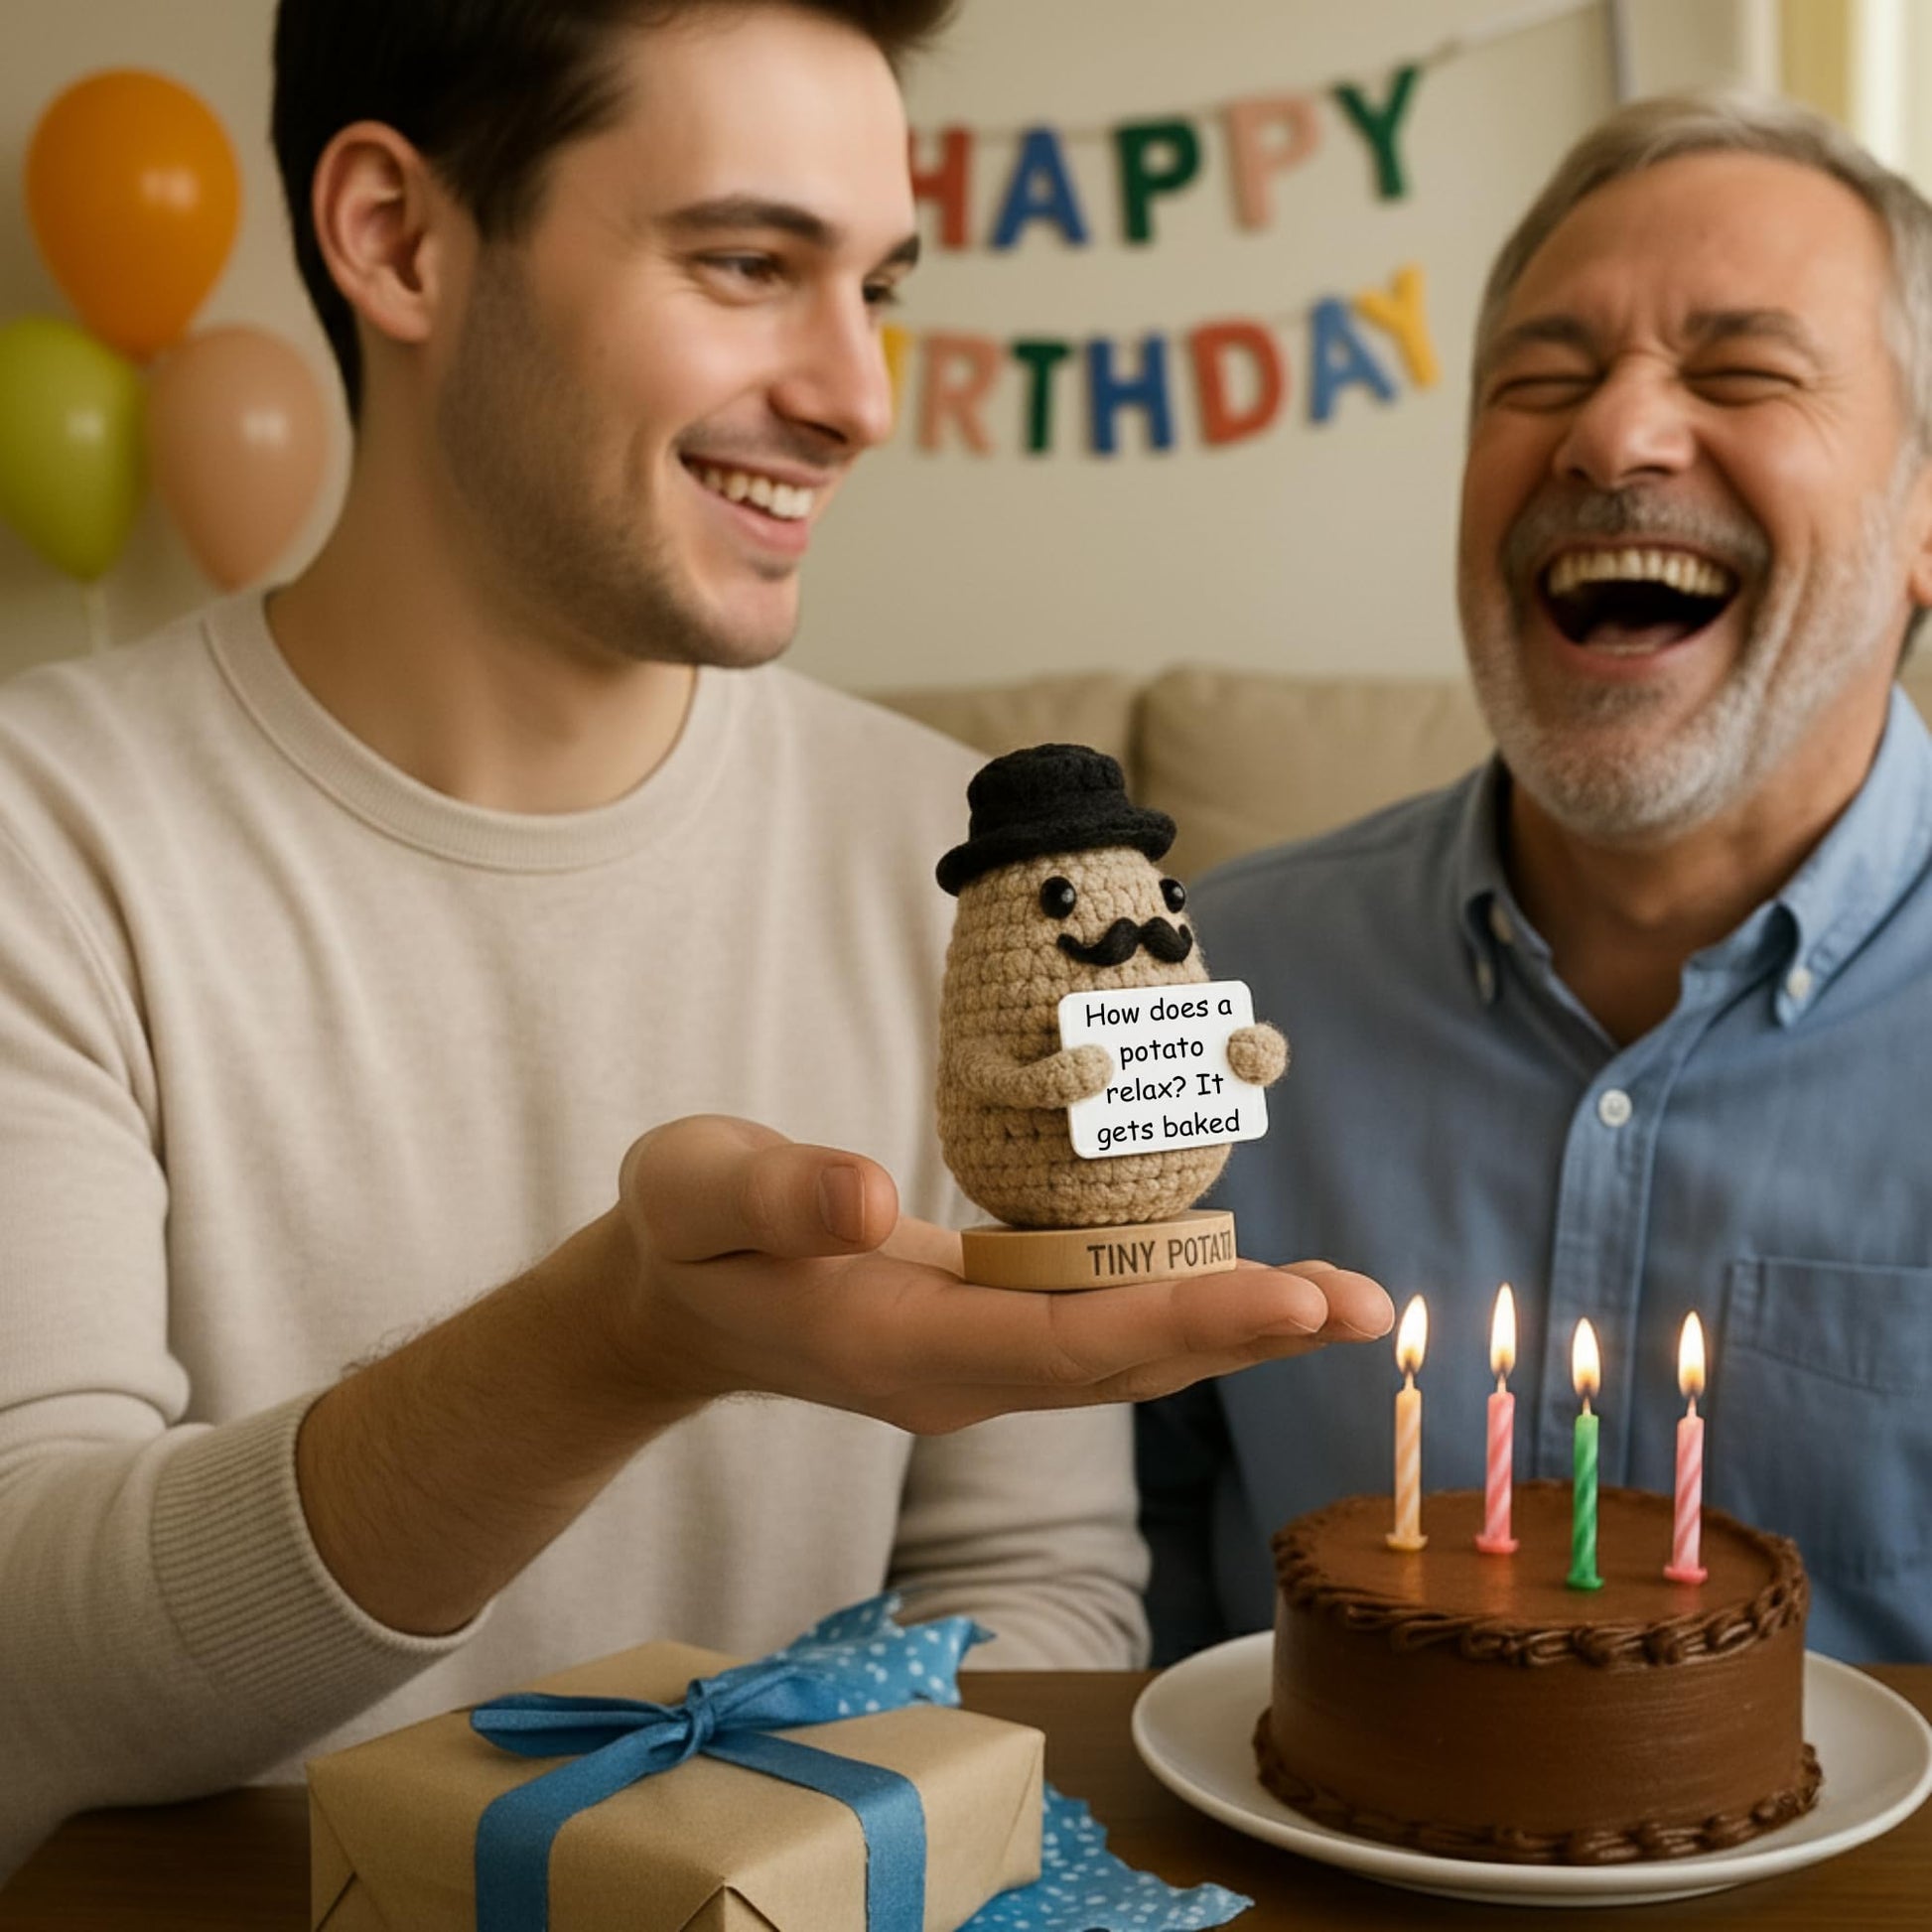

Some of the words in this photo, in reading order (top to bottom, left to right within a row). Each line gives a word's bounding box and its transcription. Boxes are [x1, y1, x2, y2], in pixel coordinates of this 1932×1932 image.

[907, 64, 1424, 252] HAPPY
[1085, 1003, 1140, 1028] How
[1150, 997, 1209, 1022] does
[1217, 998, 1233, 1016] a
[1120, 1036, 1204, 1070] potato
[1106, 1076, 1186, 1104] relax?
[1195, 1073, 1224, 1096] It
[1097, 1120, 1155, 1152] gets
[1163, 1108, 1240, 1139] baked
[1087, 1240, 1156, 1276] TINY
